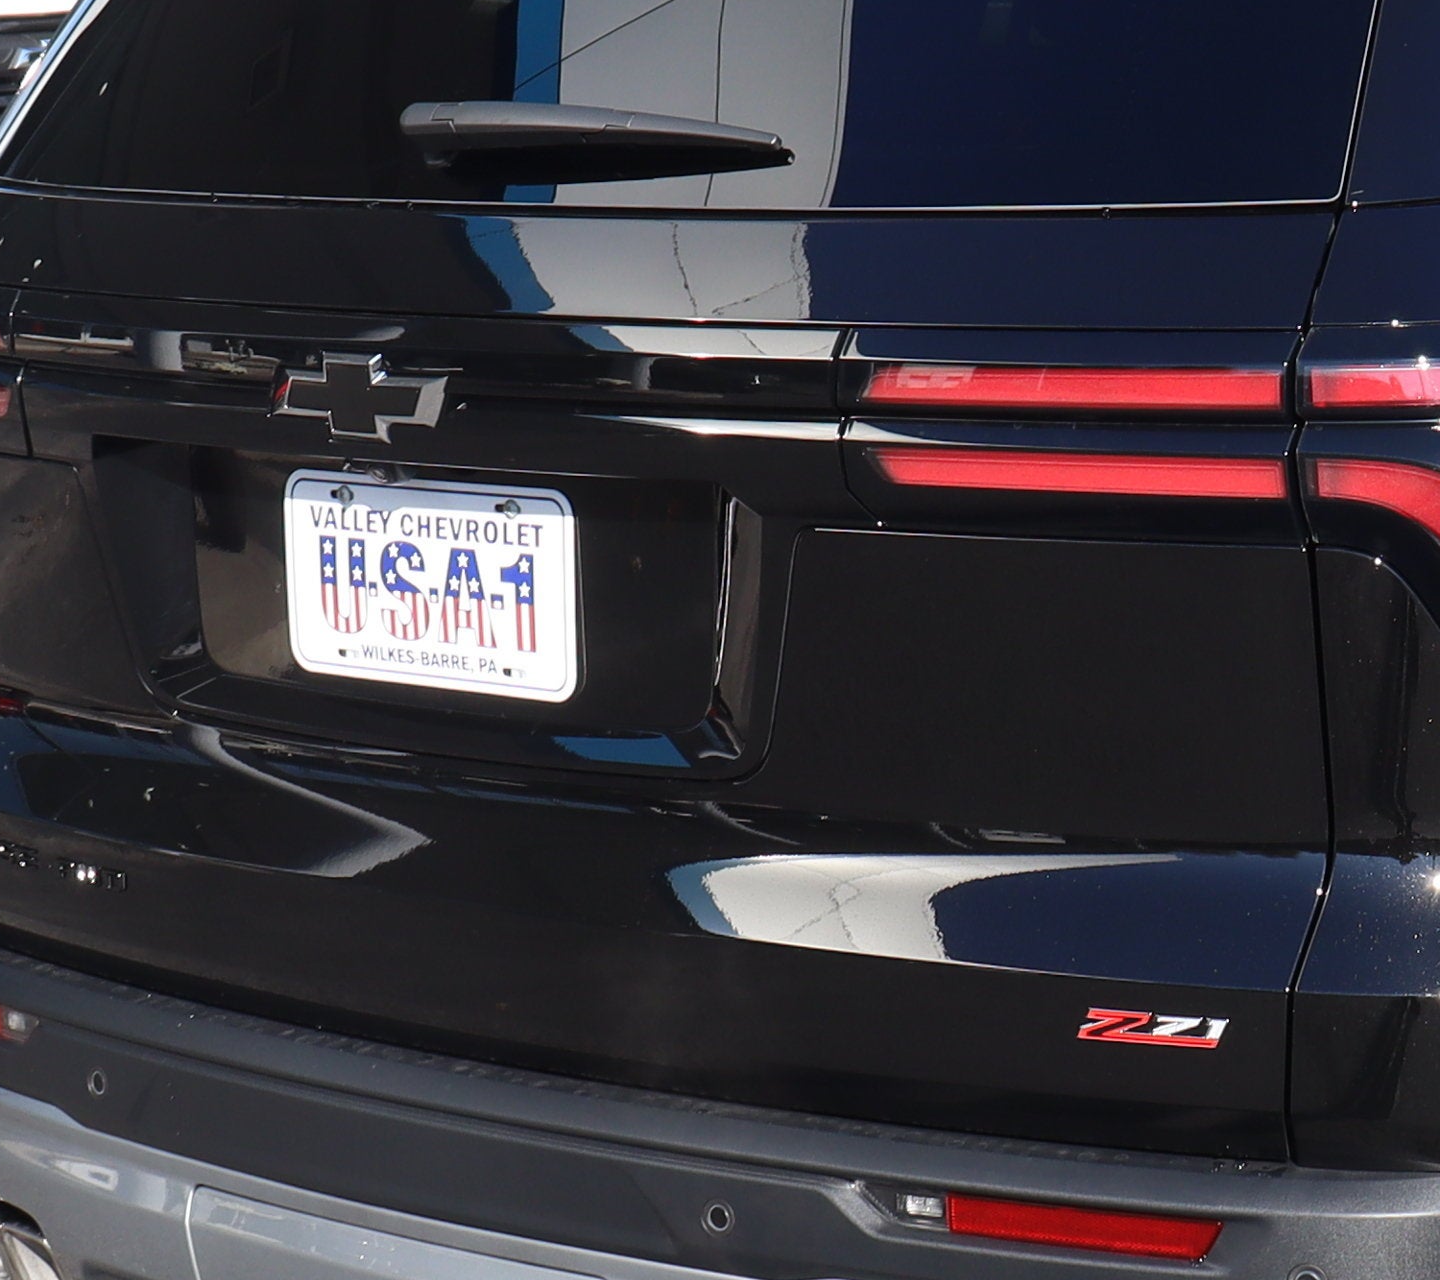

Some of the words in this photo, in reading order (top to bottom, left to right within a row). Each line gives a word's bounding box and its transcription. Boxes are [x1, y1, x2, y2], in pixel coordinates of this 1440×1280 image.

[310, 505, 394, 535] VALLEY
[400, 514, 543, 548] CHEVROLET
[361, 645, 474, 674] WILKES-BARRE,
[479, 658, 498, 675] PA
[1077, 1007, 1229, 1049] Z71
